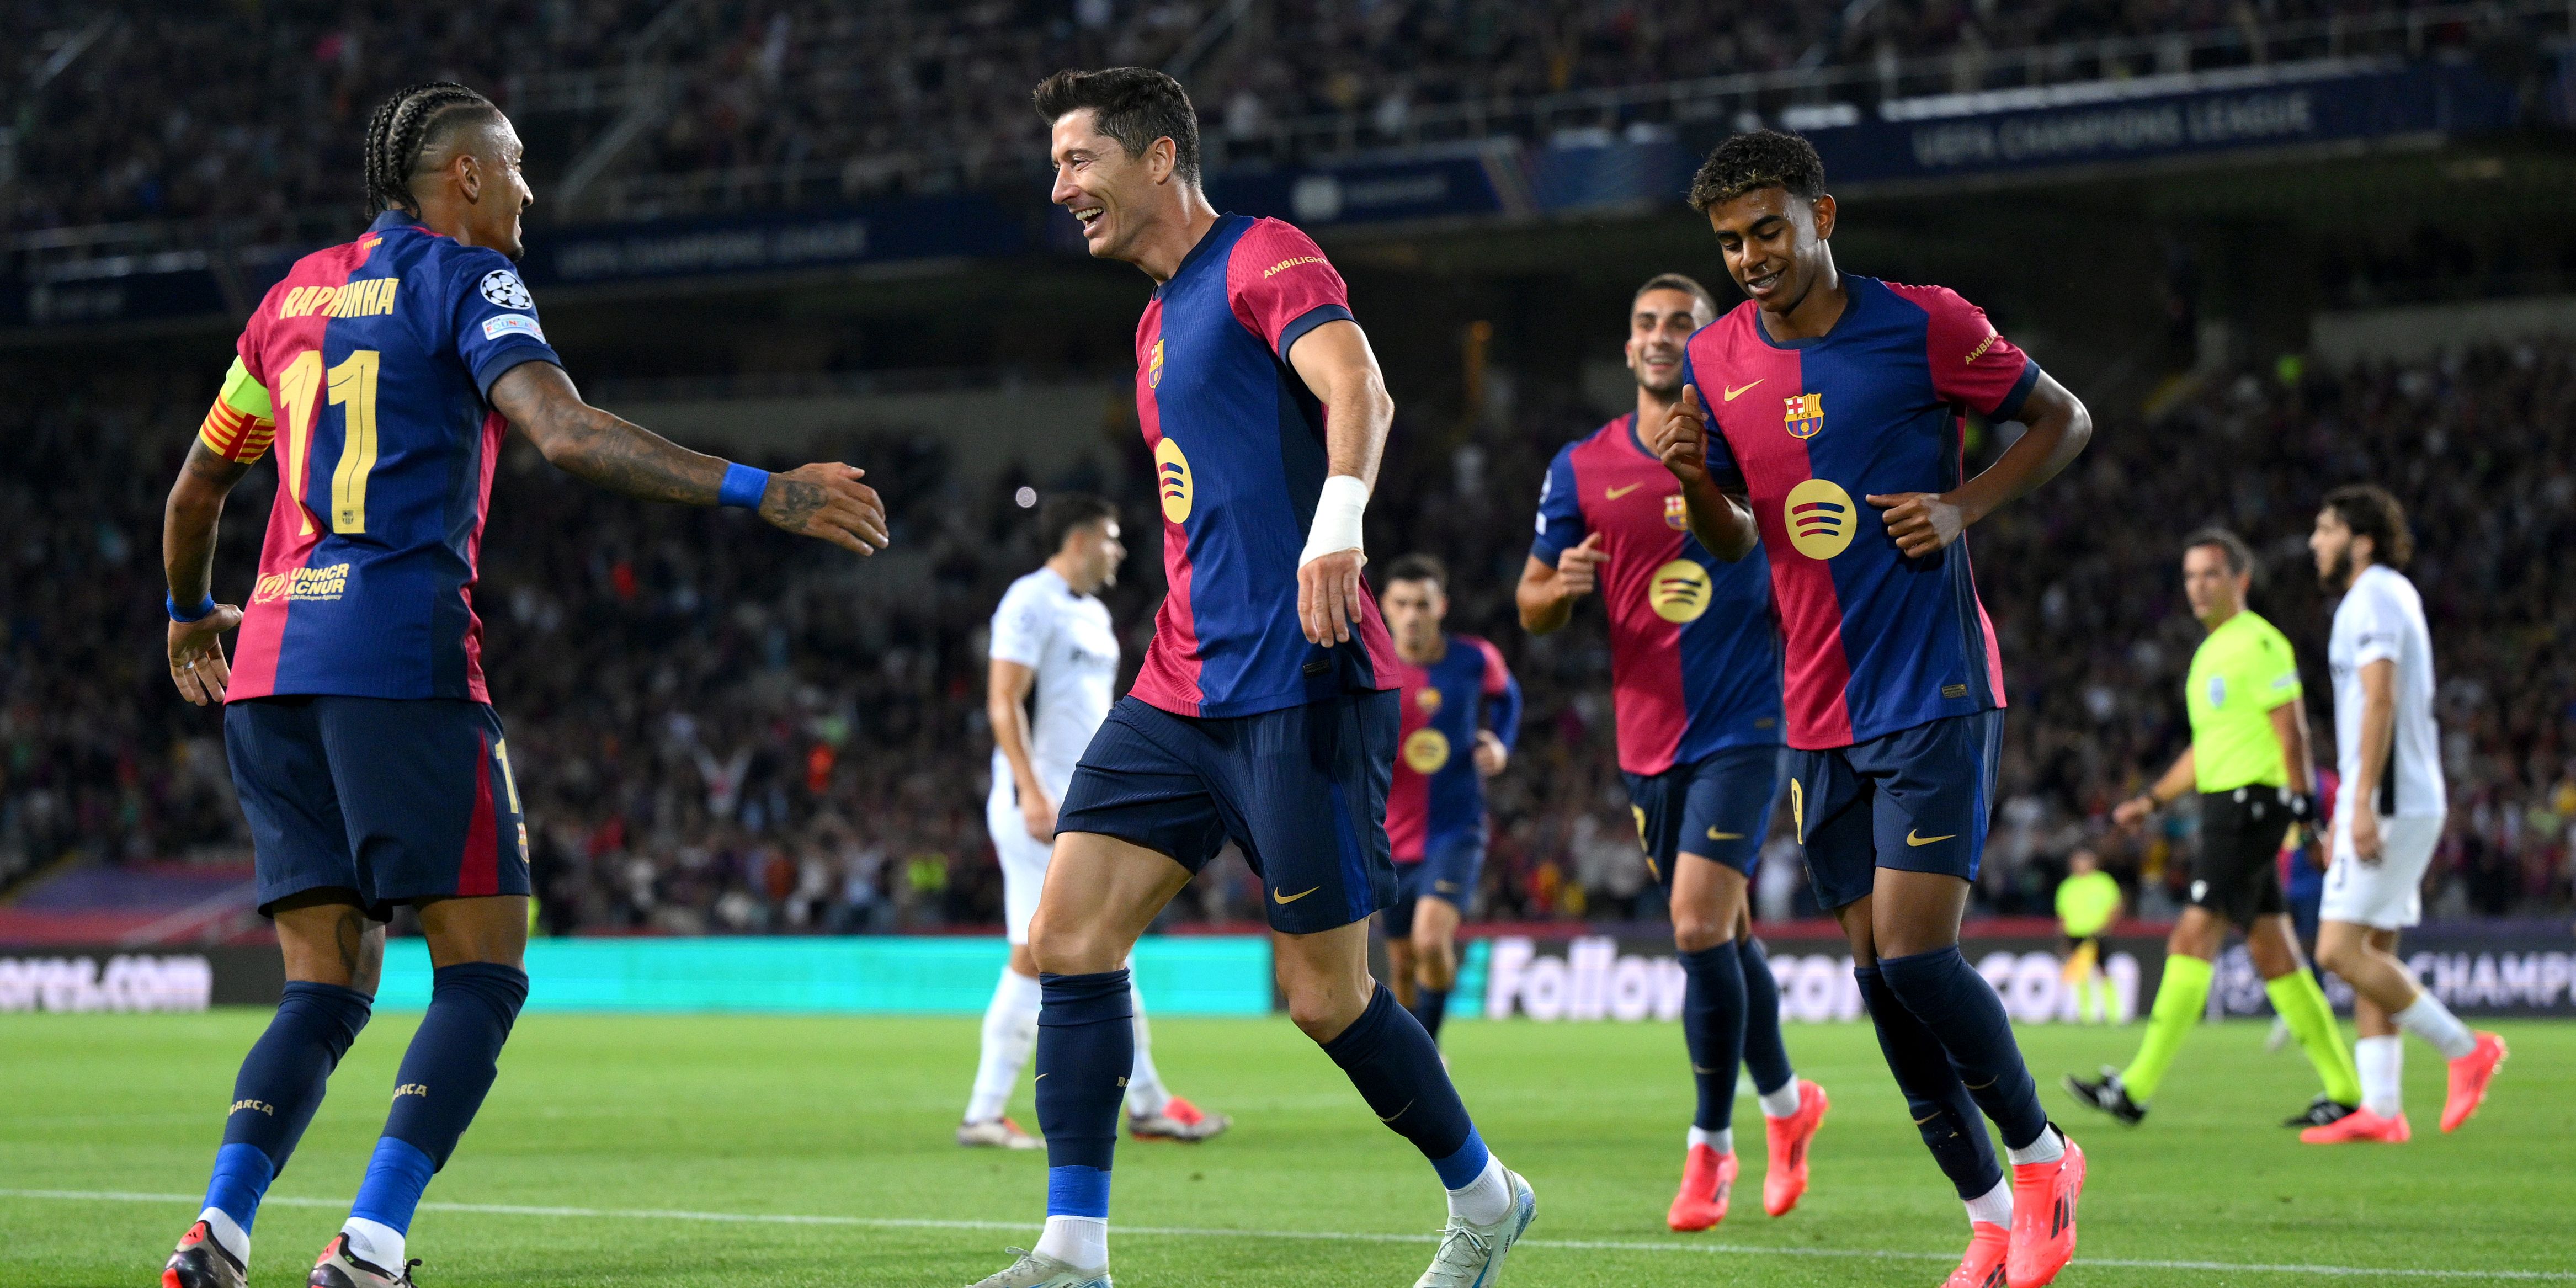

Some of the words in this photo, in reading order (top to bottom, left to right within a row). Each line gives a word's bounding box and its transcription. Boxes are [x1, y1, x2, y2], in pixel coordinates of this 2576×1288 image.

[1264, 256, 1328, 279] AMBILIGHT
[279, 278, 400, 320] RAPHINHA
[279, 350, 380, 536] 11
[290, 563, 349, 581] UNHCR
[283, 578, 345, 595] ACNUR
[395, 1083, 428, 1103] ARCA
